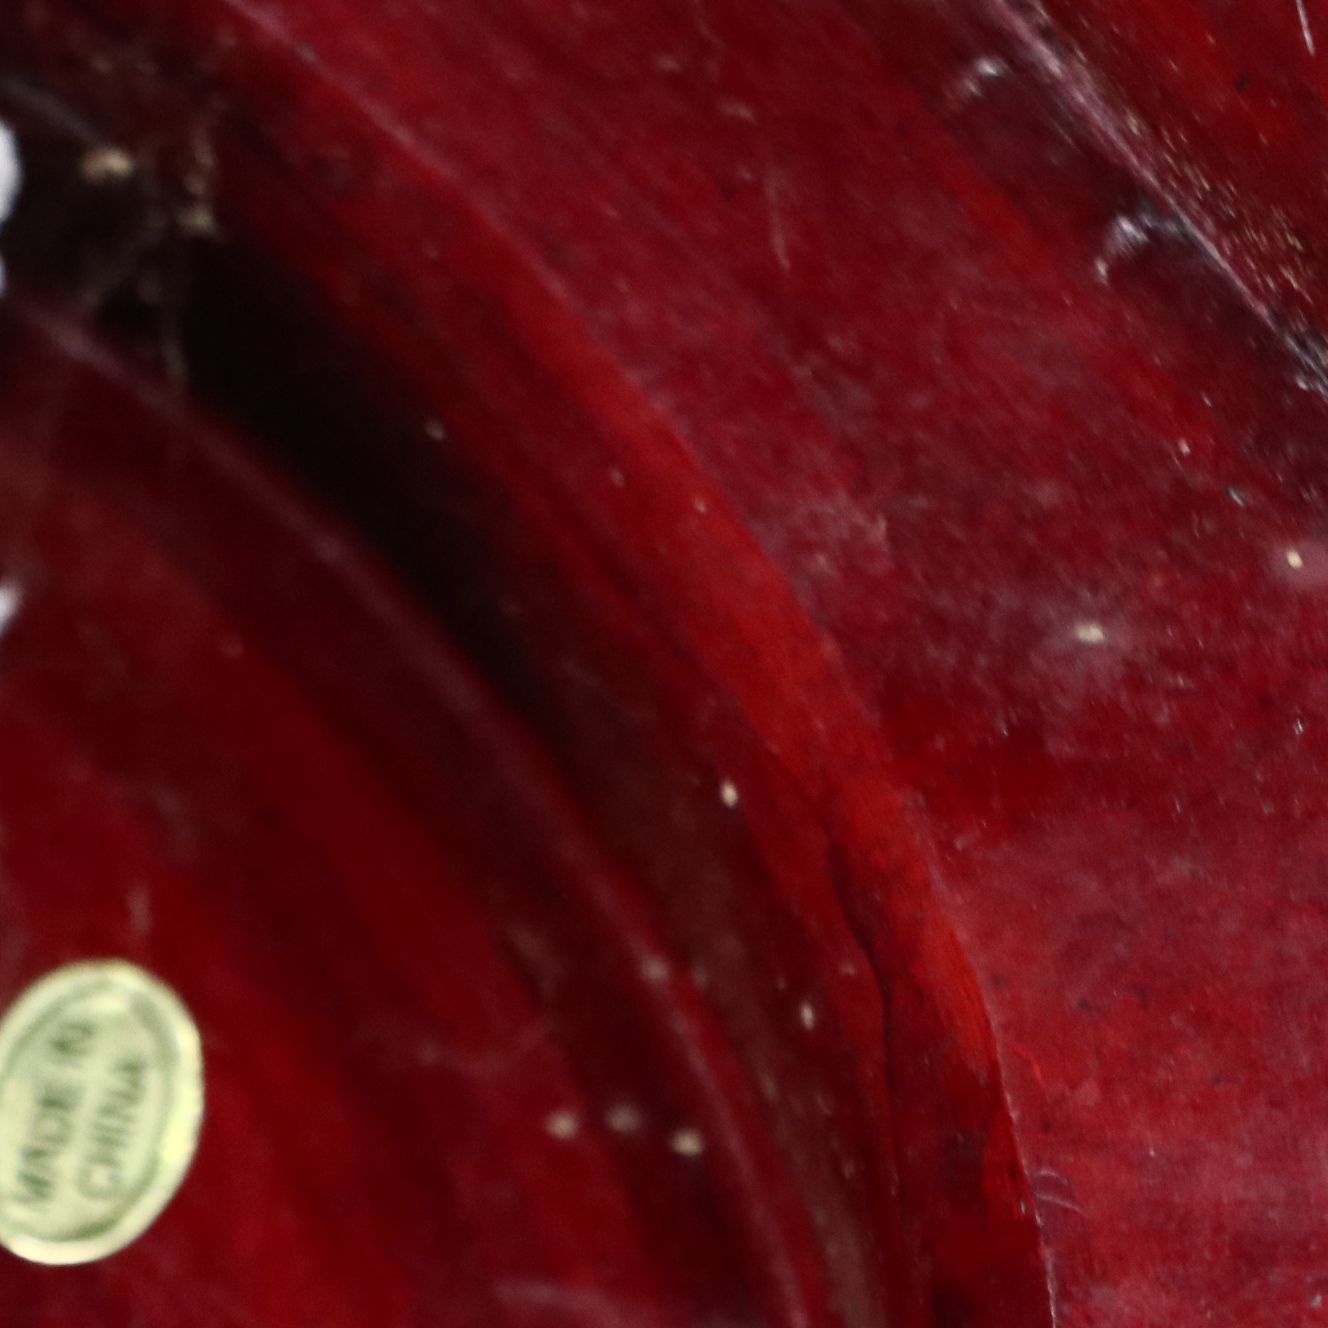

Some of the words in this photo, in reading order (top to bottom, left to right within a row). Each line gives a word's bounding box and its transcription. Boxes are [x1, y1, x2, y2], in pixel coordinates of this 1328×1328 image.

[47, 1020, 102, 1065] IN
[13, 1083, 85, 1206] MADE
[75, 1053, 149, 1199] CHINA
